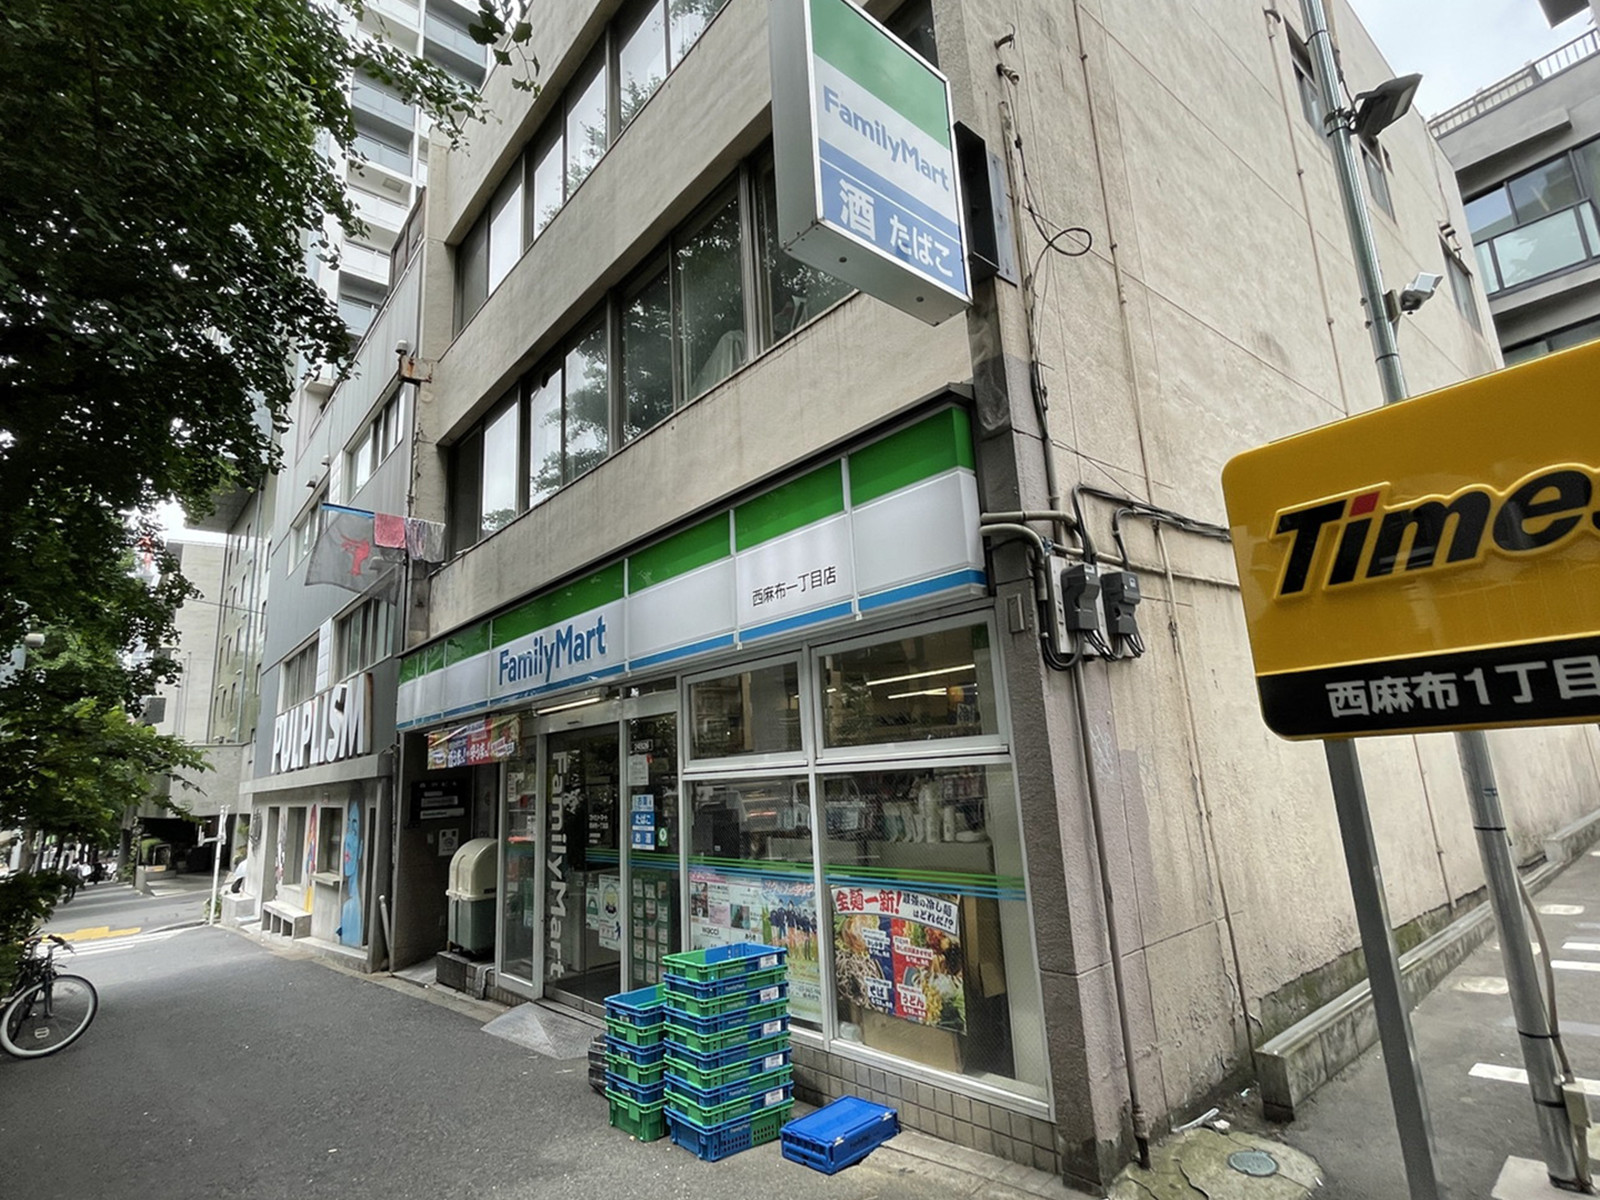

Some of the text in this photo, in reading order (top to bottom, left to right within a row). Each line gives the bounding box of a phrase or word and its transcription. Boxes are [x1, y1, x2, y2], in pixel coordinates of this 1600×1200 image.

[822, 85, 949, 192] FamilyMart
[838, 178, 953, 278] 酒 たばこ
[1275, 470, 1600, 596] Time
[751, 565, 837, 608] 西麻布一丁目店
[498, 614, 607, 687] FamilyMart
[1325, 655, 1600, 719] 西麻布1丁目
[271, 673, 369, 774] PULPLISM
[546, 751, 568, 979] FamilyMart
